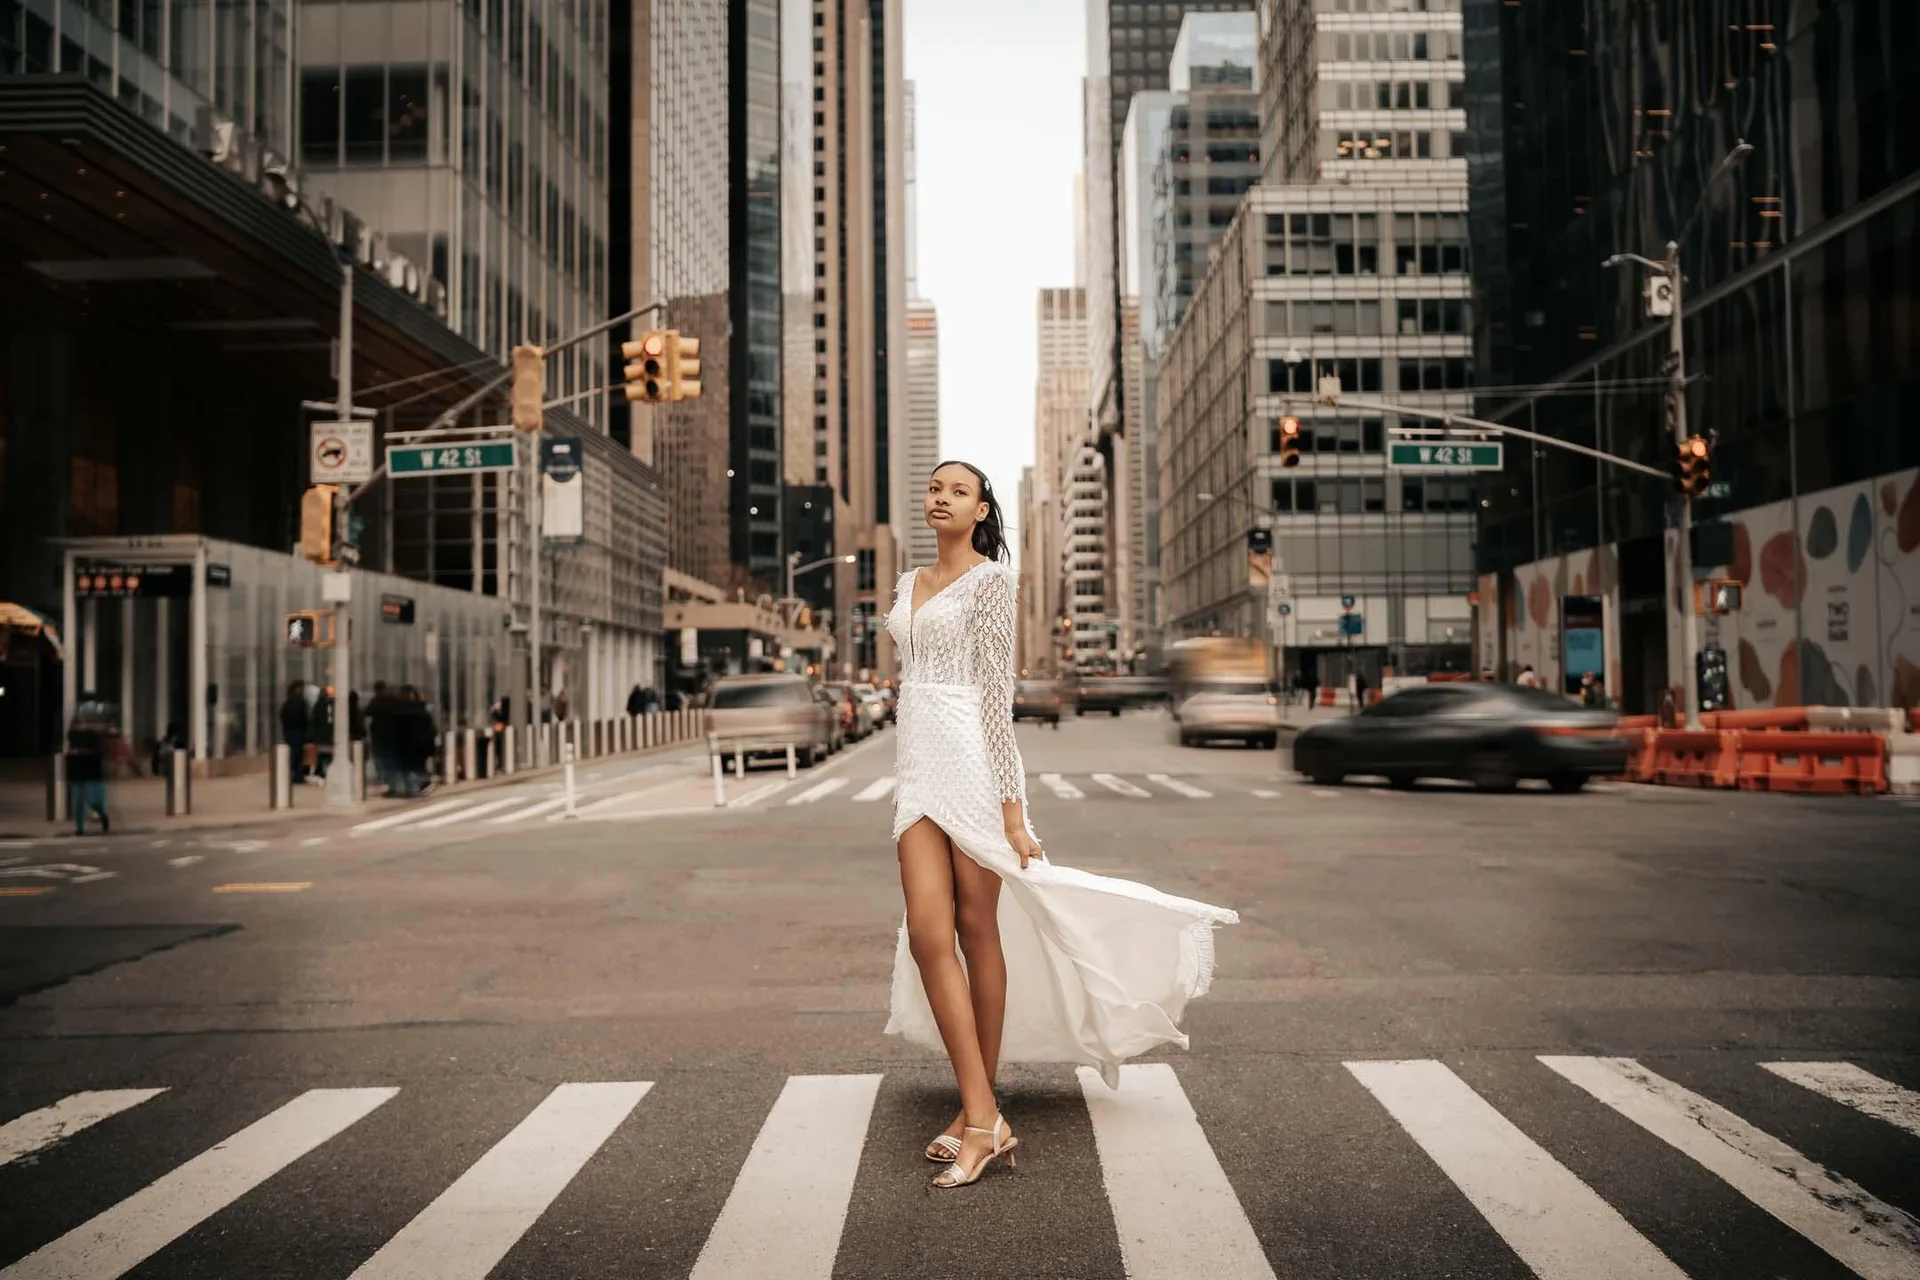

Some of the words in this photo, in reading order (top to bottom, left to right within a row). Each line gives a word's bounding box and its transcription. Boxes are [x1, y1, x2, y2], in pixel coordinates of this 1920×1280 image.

[420, 450, 434, 468] W
[438, 449, 460, 468] 42
[464, 448, 482, 467] St
[1419, 447, 1432, 463] W
[1435, 447, 1454, 463] 42
[1457, 447, 1472, 463] St
